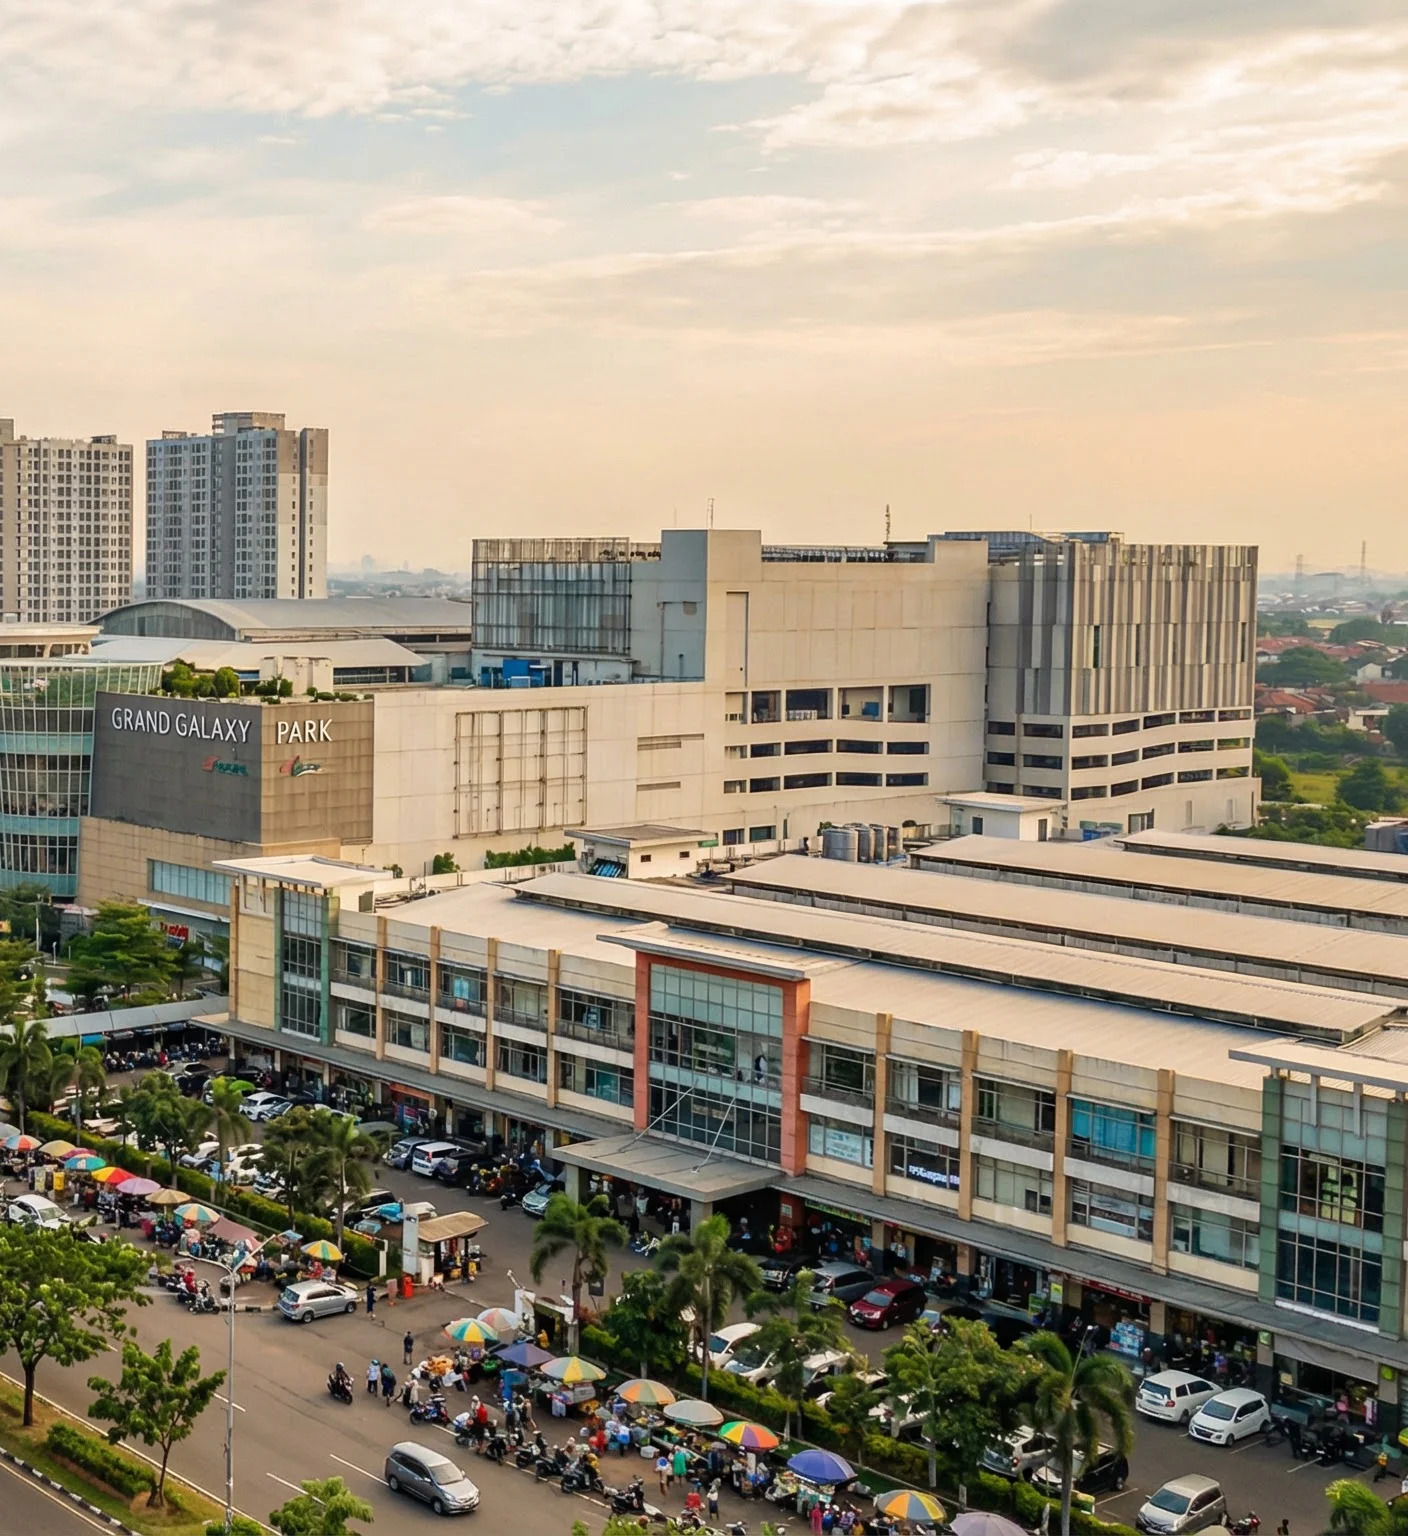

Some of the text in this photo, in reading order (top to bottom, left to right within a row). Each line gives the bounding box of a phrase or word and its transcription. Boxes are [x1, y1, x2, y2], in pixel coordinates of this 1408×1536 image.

[111, 707, 333, 744] GRAND GALAXY PARK
